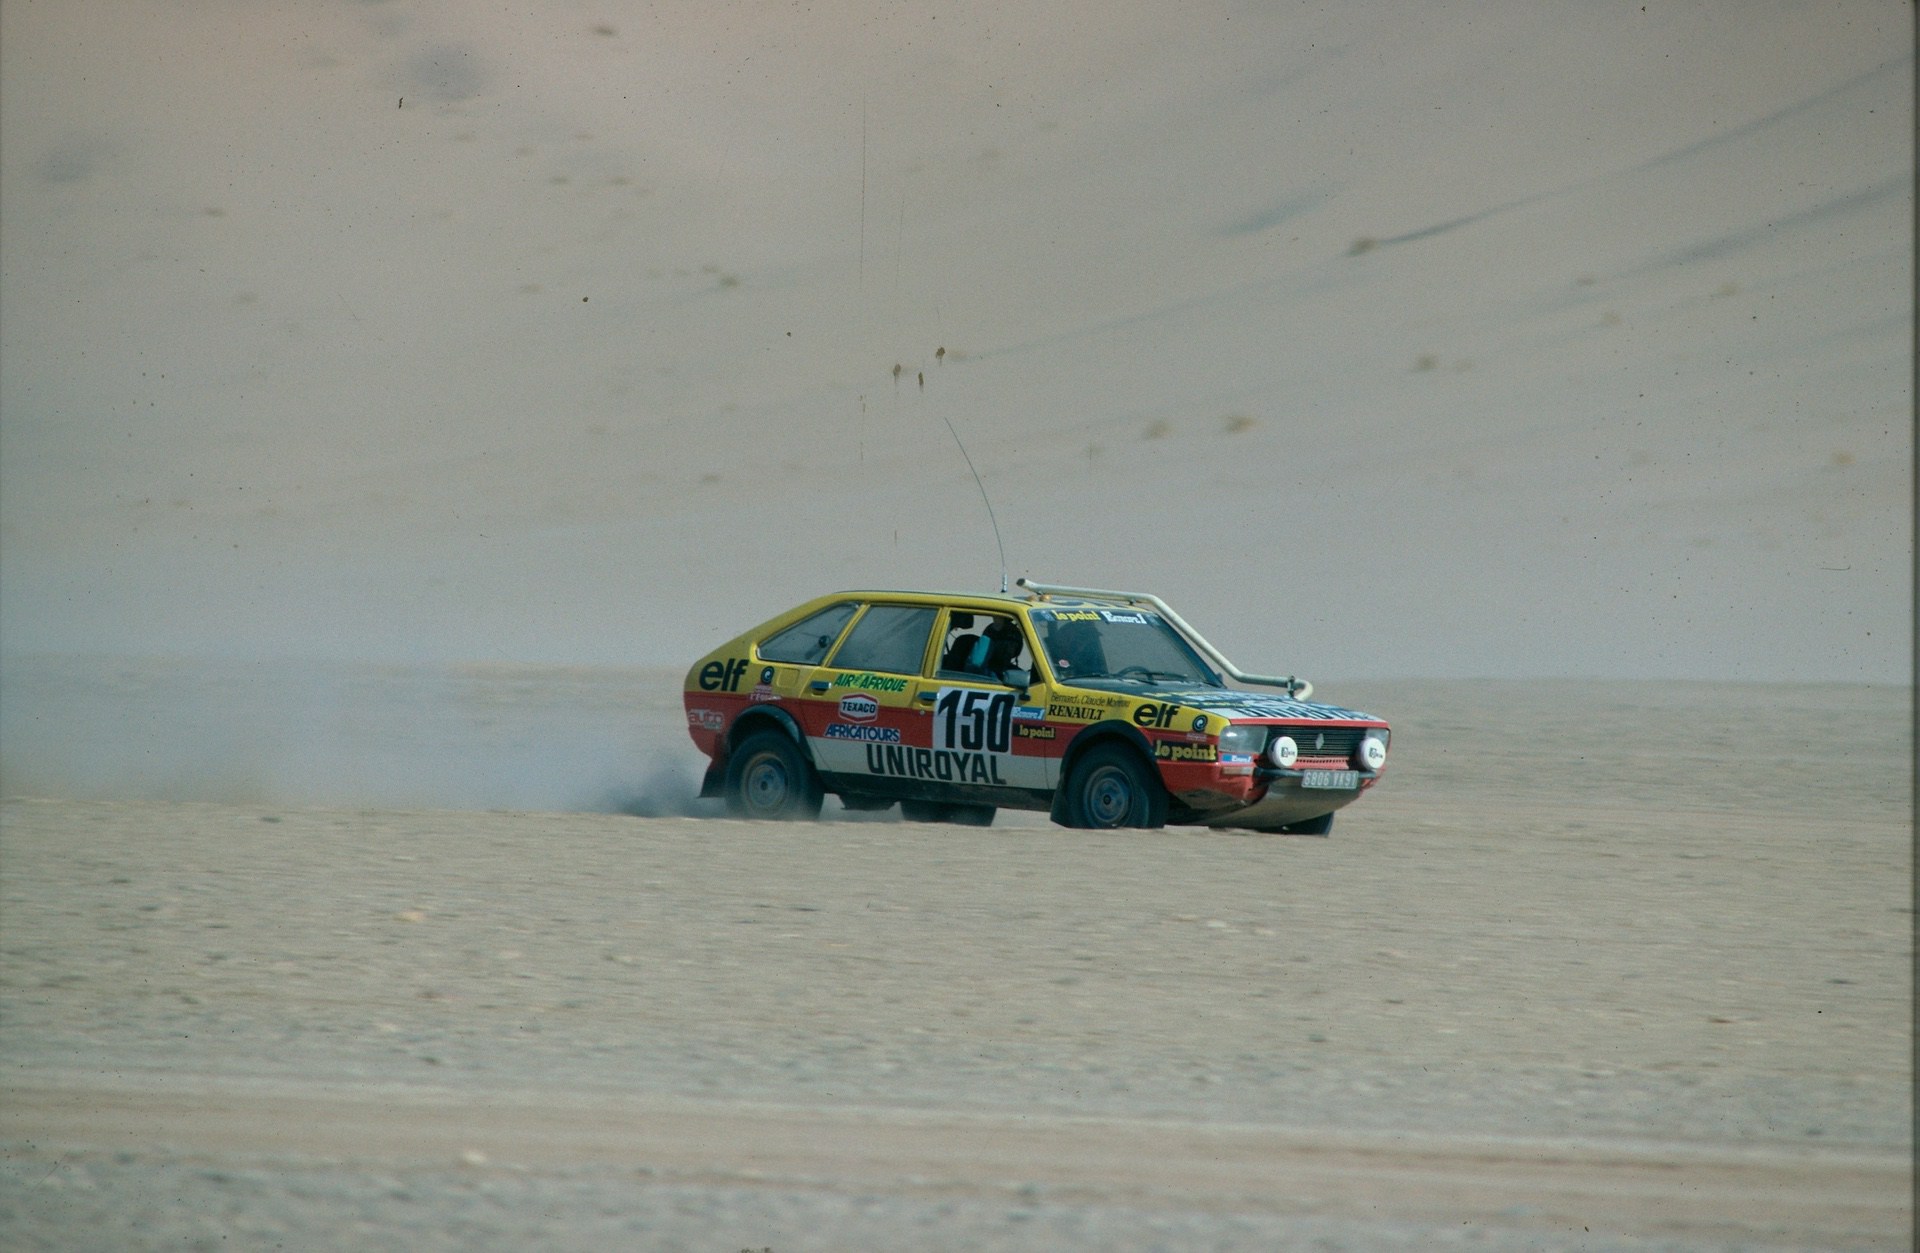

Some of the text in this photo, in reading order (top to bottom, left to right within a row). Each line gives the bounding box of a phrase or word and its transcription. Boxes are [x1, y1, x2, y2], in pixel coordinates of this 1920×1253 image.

[699, 658, 749, 692] elf
[834, 673, 908, 692] AIR AFRIQUE
[842, 701, 876, 713] TEXACO
[1048, 704, 1105, 720] RENAULT
[1133, 703, 1180, 728] elf
[938, 690, 1017, 753] 150
[824, 723, 900, 742] AFRICATOURS
[1155, 740, 1171, 756] le
[1171, 743, 1217, 760] point
[866, 743, 1008, 785] UNIROYAL
